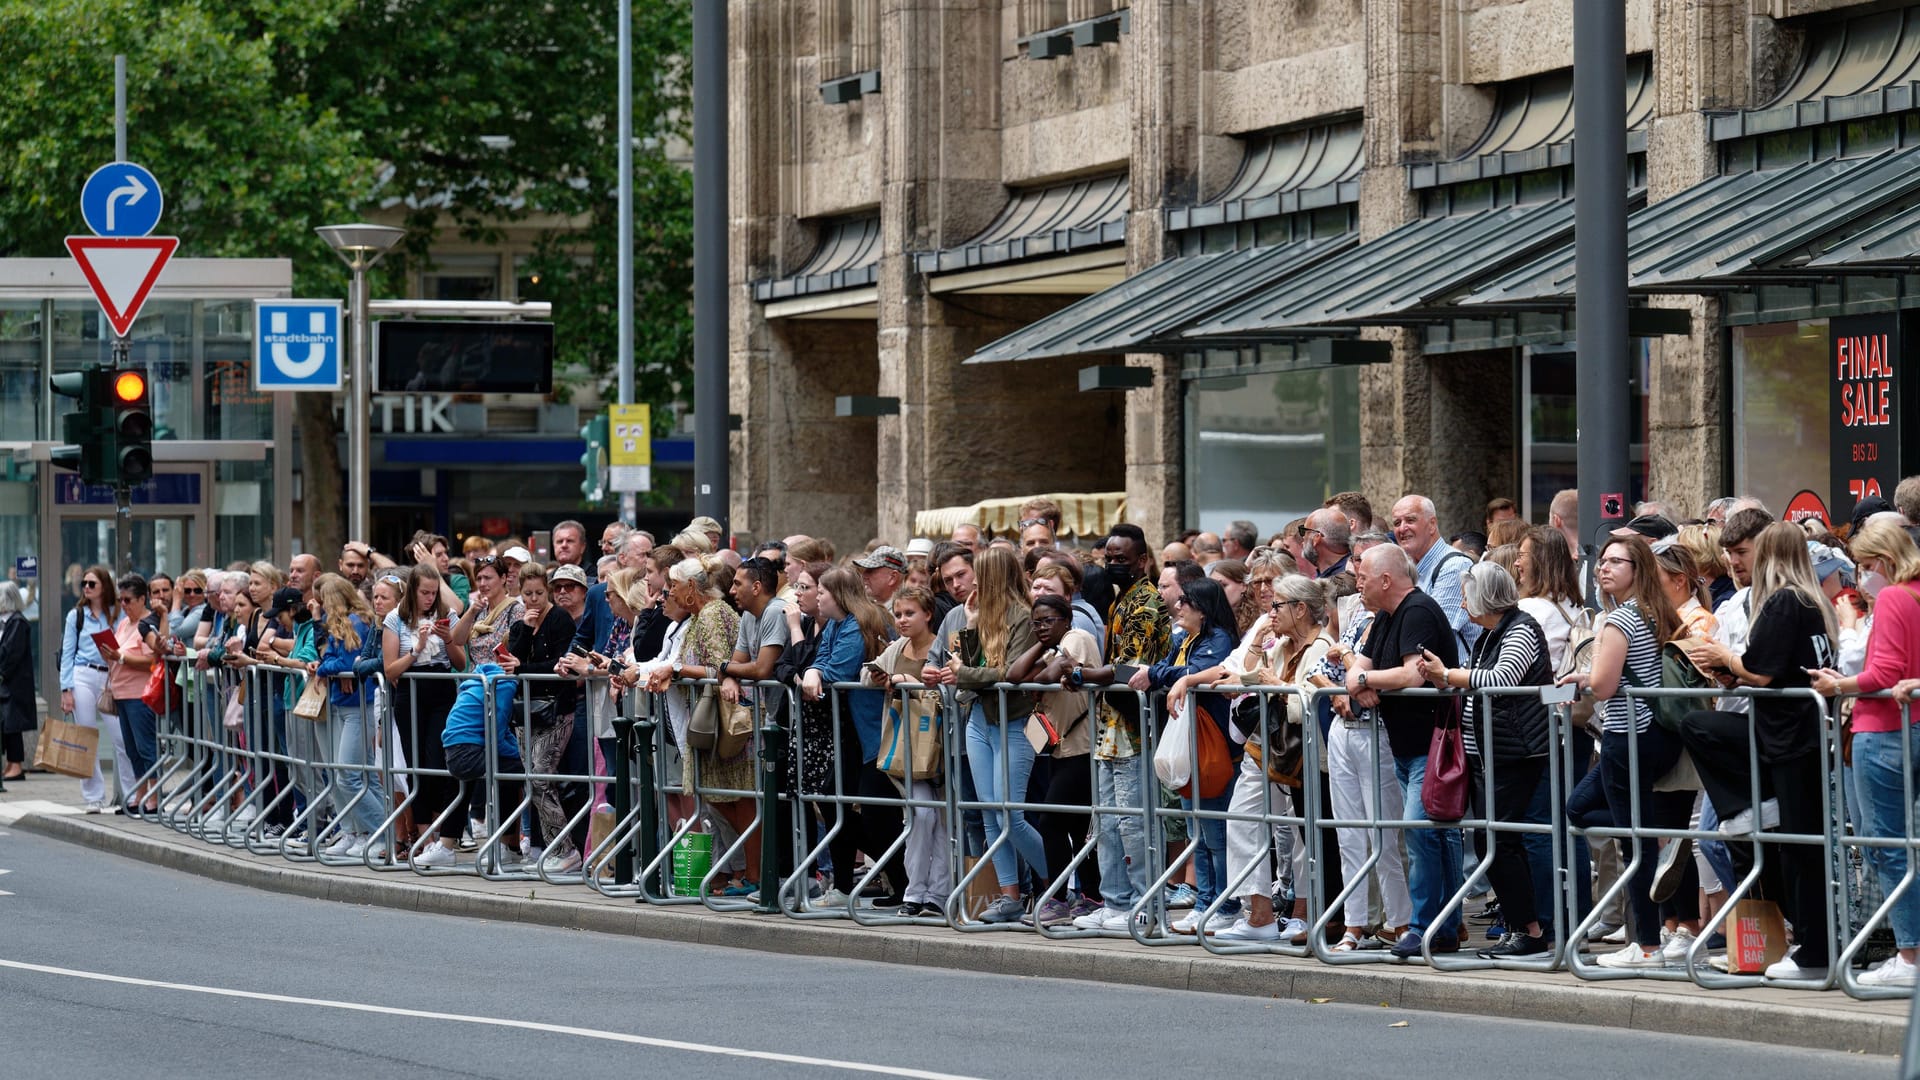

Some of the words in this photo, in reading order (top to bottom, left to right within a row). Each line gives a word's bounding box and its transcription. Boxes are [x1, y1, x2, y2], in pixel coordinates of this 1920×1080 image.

[264, 333, 334, 343] stadtbahn
[271, 312, 326, 379] U
[1837, 334, 1893, 381] FINAL
[1841, 381, 1890, 427] SALE
[1852, 444, 1866, 462] BIS
[1867, 443, 1878, 461] ZU
[1741, 917, 1761, 931] THE
[1743, 933, 1767, 948] ONLY
[1744, 949, 1765, 963] BAG
